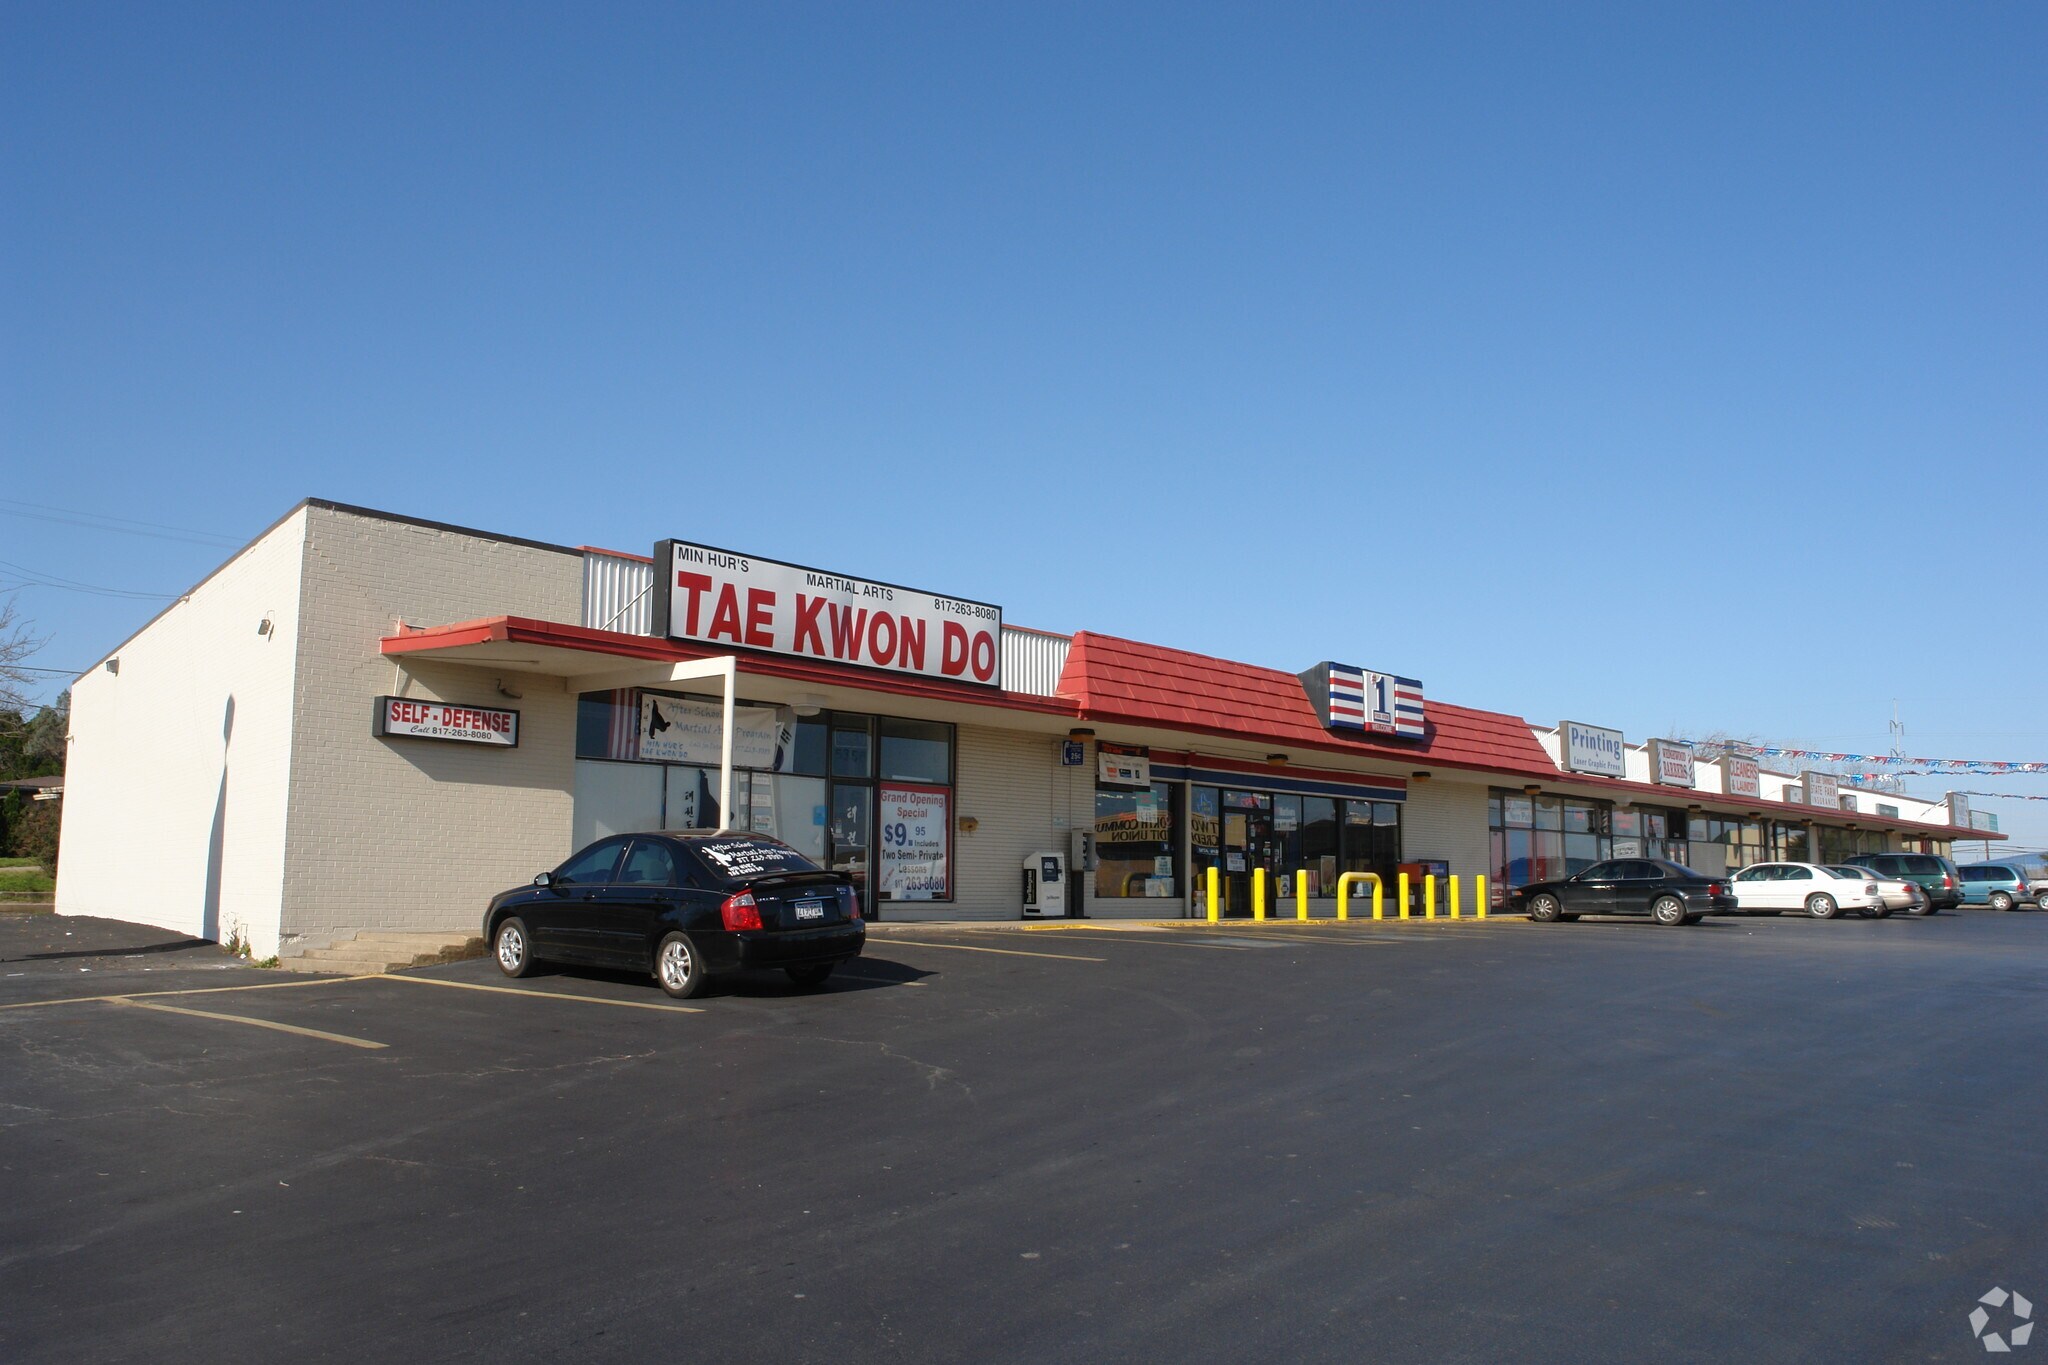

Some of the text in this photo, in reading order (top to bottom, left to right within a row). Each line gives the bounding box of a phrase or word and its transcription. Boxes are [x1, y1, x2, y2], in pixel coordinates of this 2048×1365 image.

[678, 546, 750, 573] MIN HUR'S
[806, 573, 894, 602] MARTIAL ARTS
[934, 598, 997, 621] 817-263-8080
[678, 570, 996, 682] TAE KWON DO
[391, 702, 430, 724] SELF
[442, 707, 511, 733] DEFENSE
[410, 725, 492, 740] Call 817-263-8080
[1571, 727, 1620, 761] Printing
[1588, 758, 1607, 770] Graphic
[1730, 760, 1758, 780] CLEANERS
[1737, 781, 1757, 793] LAUNDRY
[880, 791, 944, 808] Grand Opening
[897, 807, 928, 819] Special
[882, 849, 896, 860] Two
[918, 850, 944, 860] Private
[898, 863, 927, 874] Lessons
[906, 876, 945, 890] 263-8080
